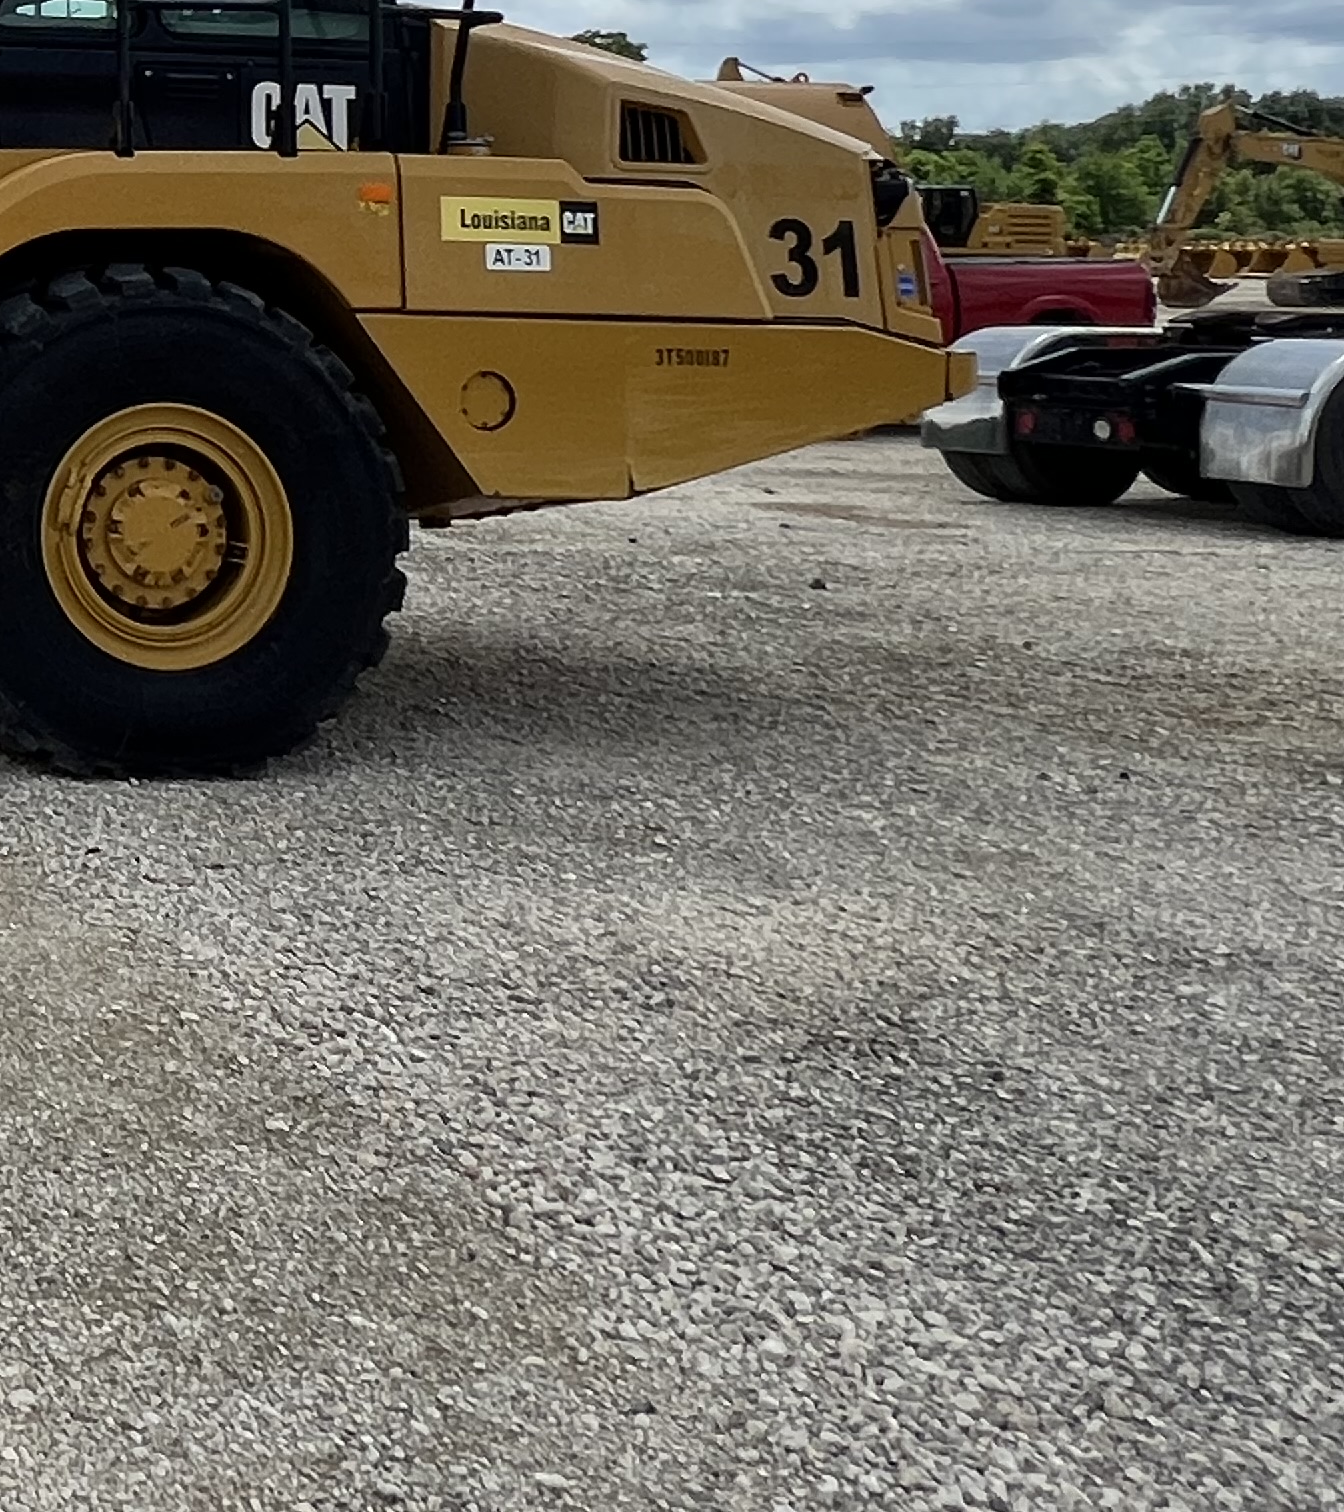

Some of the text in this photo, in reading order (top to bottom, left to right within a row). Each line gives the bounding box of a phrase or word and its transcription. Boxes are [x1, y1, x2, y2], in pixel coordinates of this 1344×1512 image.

[251, 81, 356, 152] CAT
[459, 208, 596, 235] Louisiana CAT
[492, 248, 542, 266] AT-31
[768, 218, 860, 298] 31
